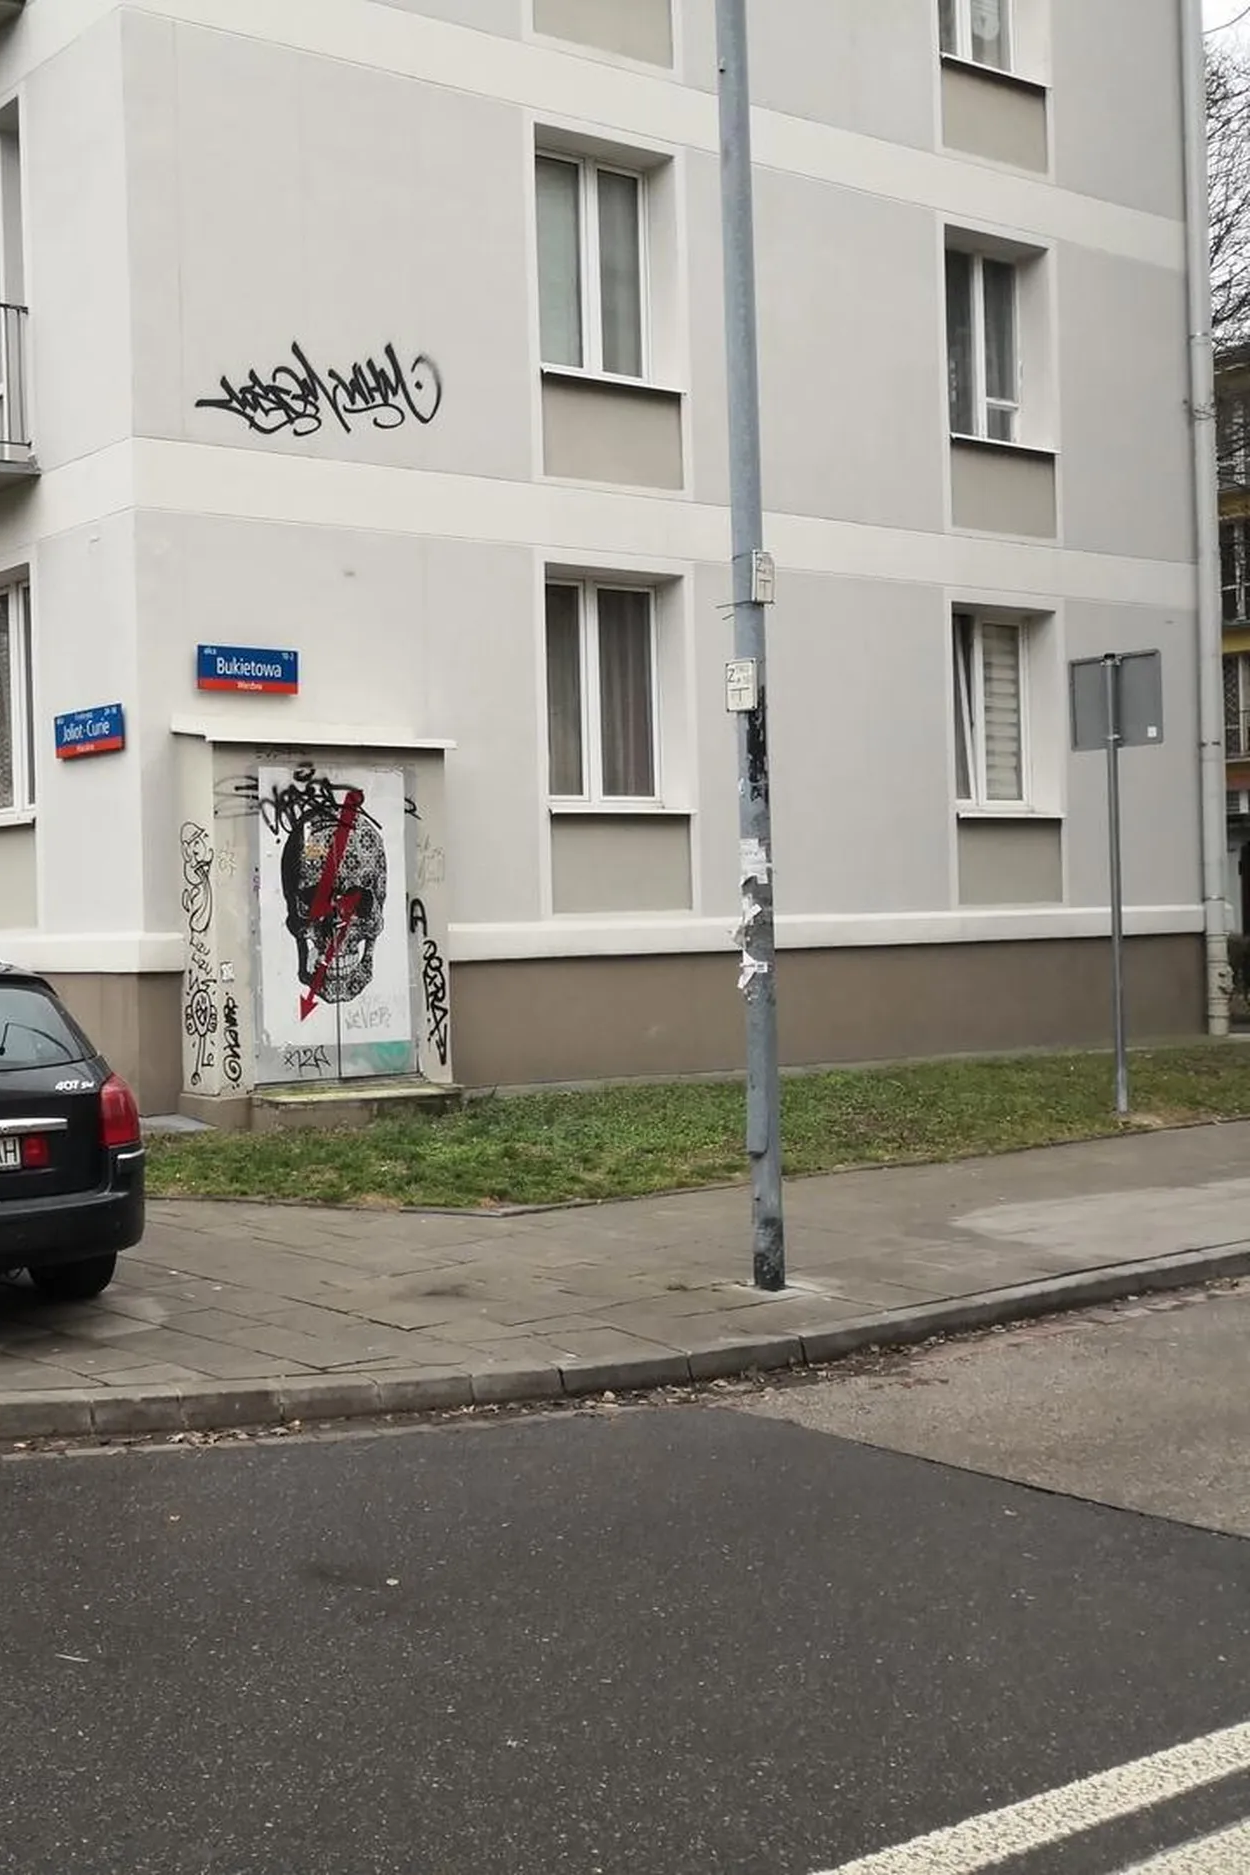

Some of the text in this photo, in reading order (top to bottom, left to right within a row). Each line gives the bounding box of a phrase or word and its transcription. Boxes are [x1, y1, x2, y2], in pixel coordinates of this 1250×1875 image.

[216, 656, 283, 678] Bukietowa
[62, 719, 111, 743] Joliot-Curie
[54, 1079, 79, 1091] 407
